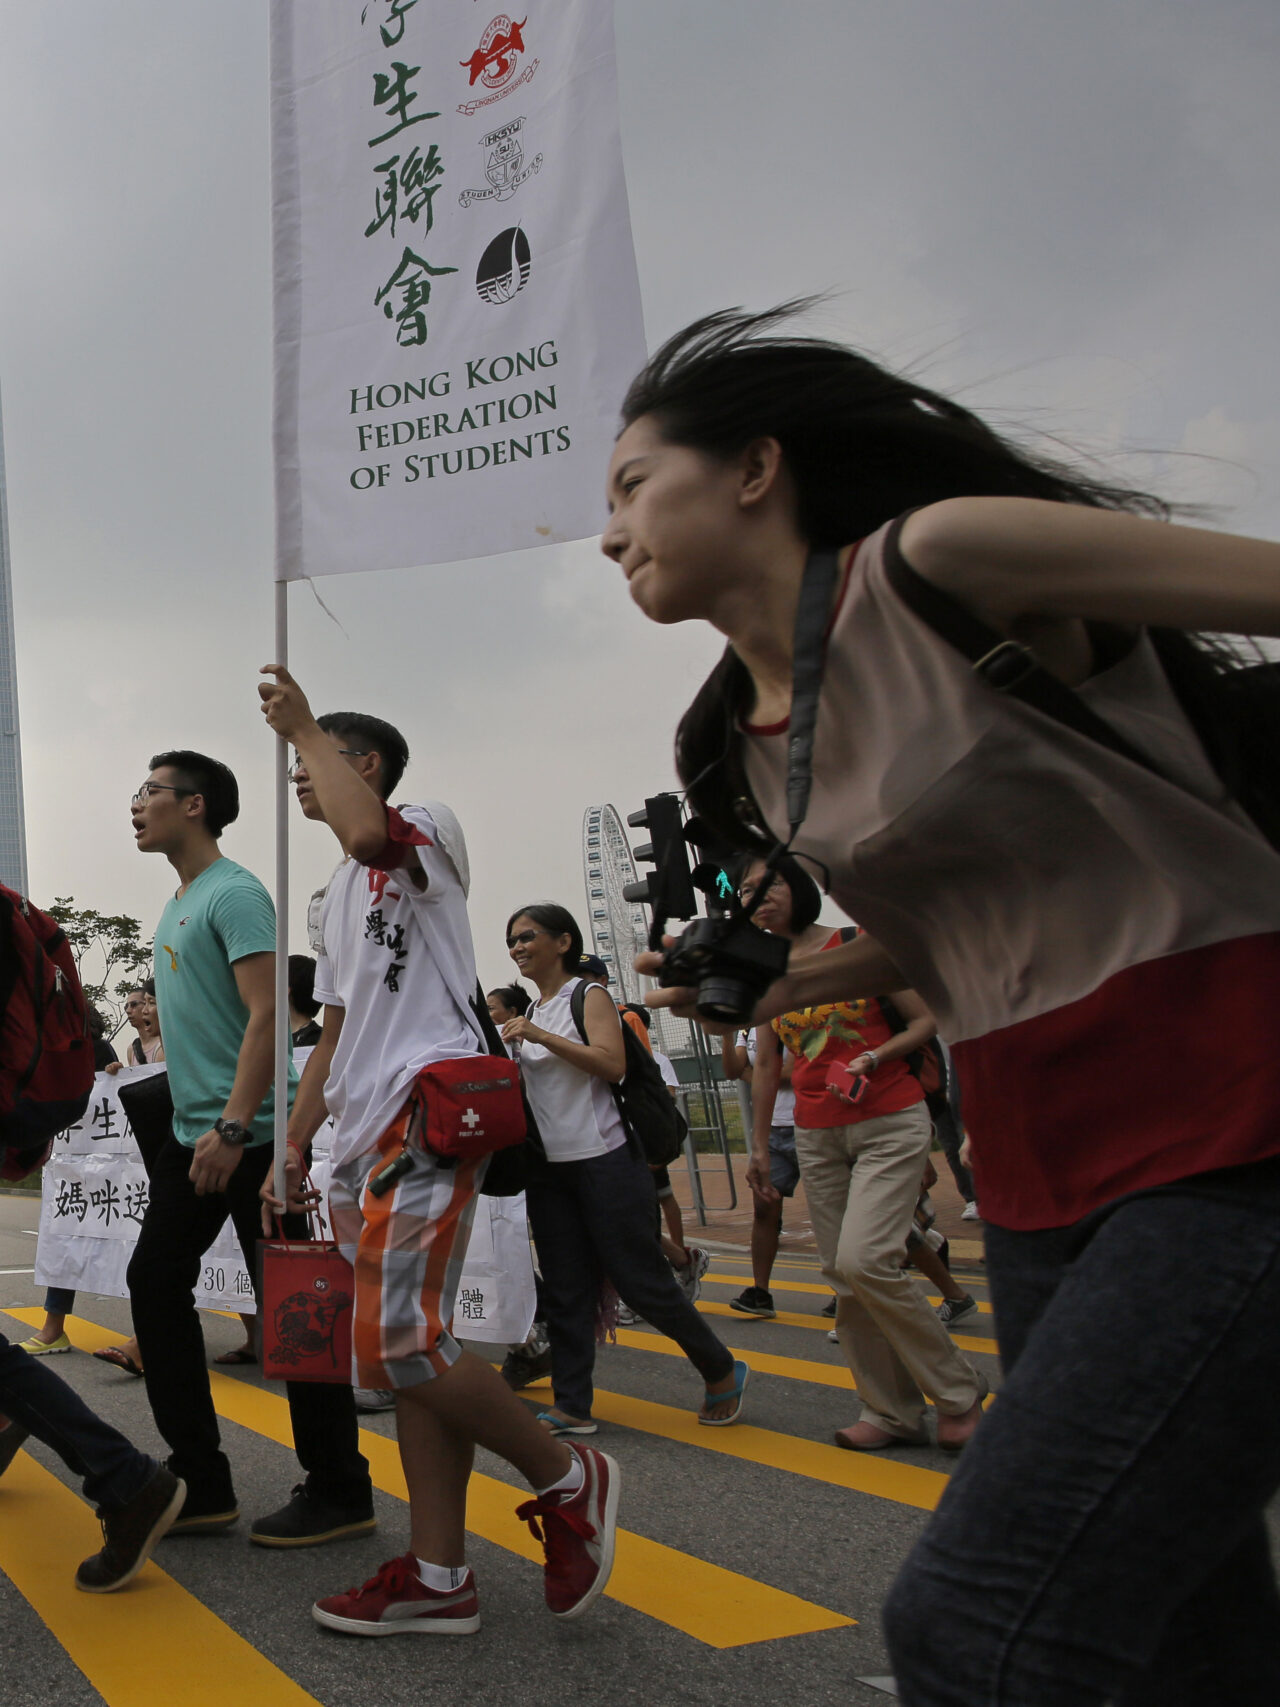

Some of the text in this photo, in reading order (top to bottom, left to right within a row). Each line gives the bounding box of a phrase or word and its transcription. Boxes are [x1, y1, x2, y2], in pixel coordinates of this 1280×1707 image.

[487, 122, 520, 144] HKSYU
[349, 341, 558, 414] HONG KONG
[356, 384, 557, 451] FEDERATION
[349, 425, 571, 490] OF STUDENTS
[53, 1178, 150, 1227] 媽咪送
[204, 1266, 225, 1292] 30
[458, 1288, 487, 1321] 體
